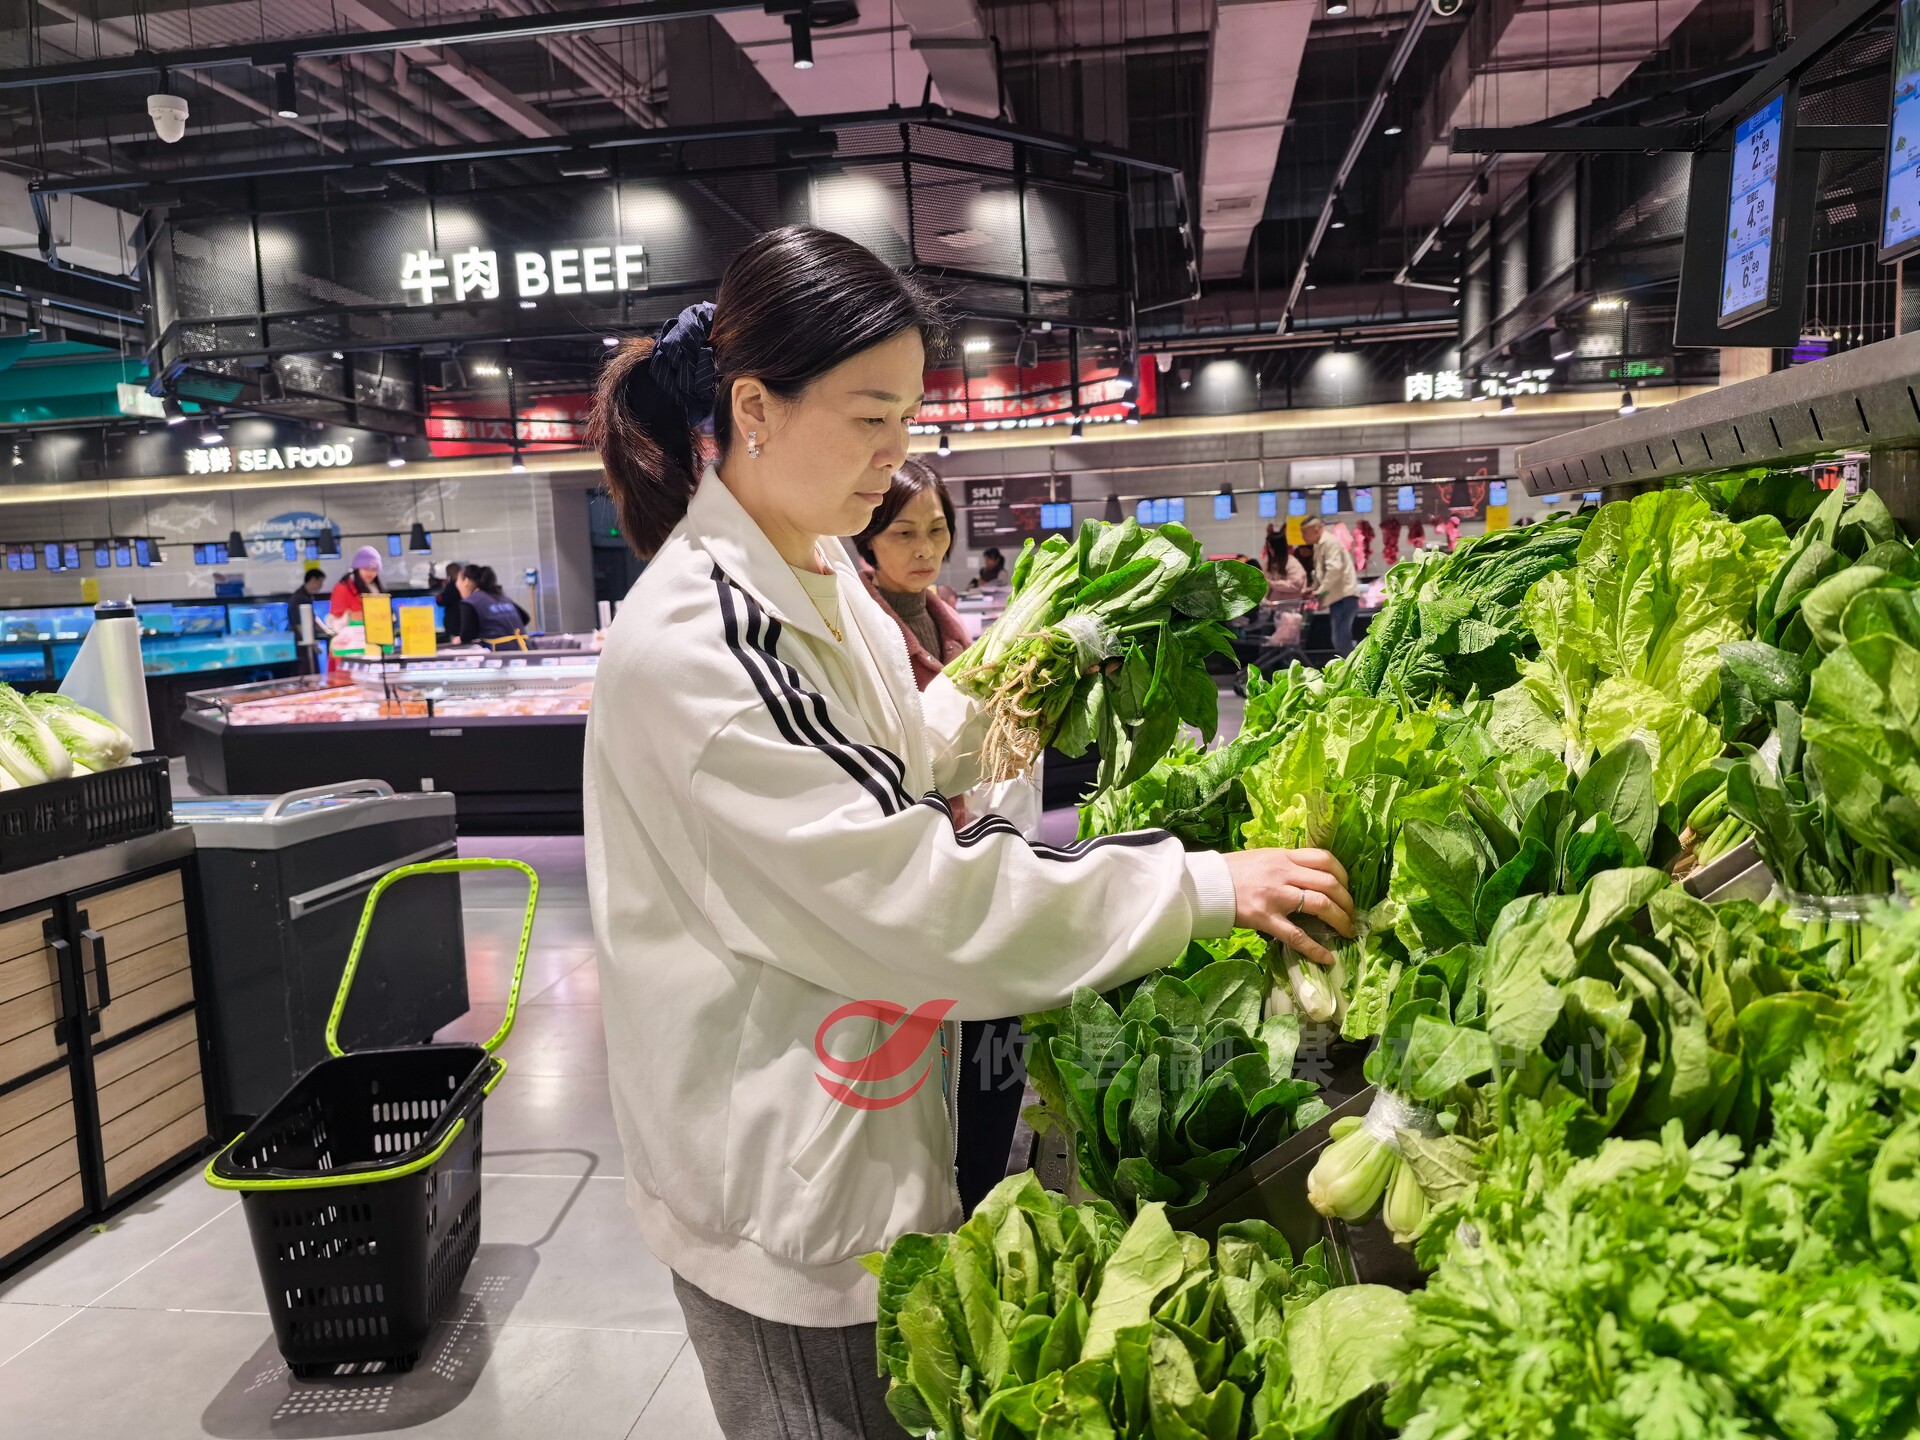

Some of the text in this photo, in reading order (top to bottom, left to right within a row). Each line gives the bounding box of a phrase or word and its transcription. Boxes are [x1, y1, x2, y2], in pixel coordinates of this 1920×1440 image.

[401, 246, 643, 304] 牛肉 BEEF
[1405, 371, 1464, 401] 肉类
[186, 443, 353, 474] 海鲜 SEA FOOD
[972, 487, 1004, 499] SPLIT
